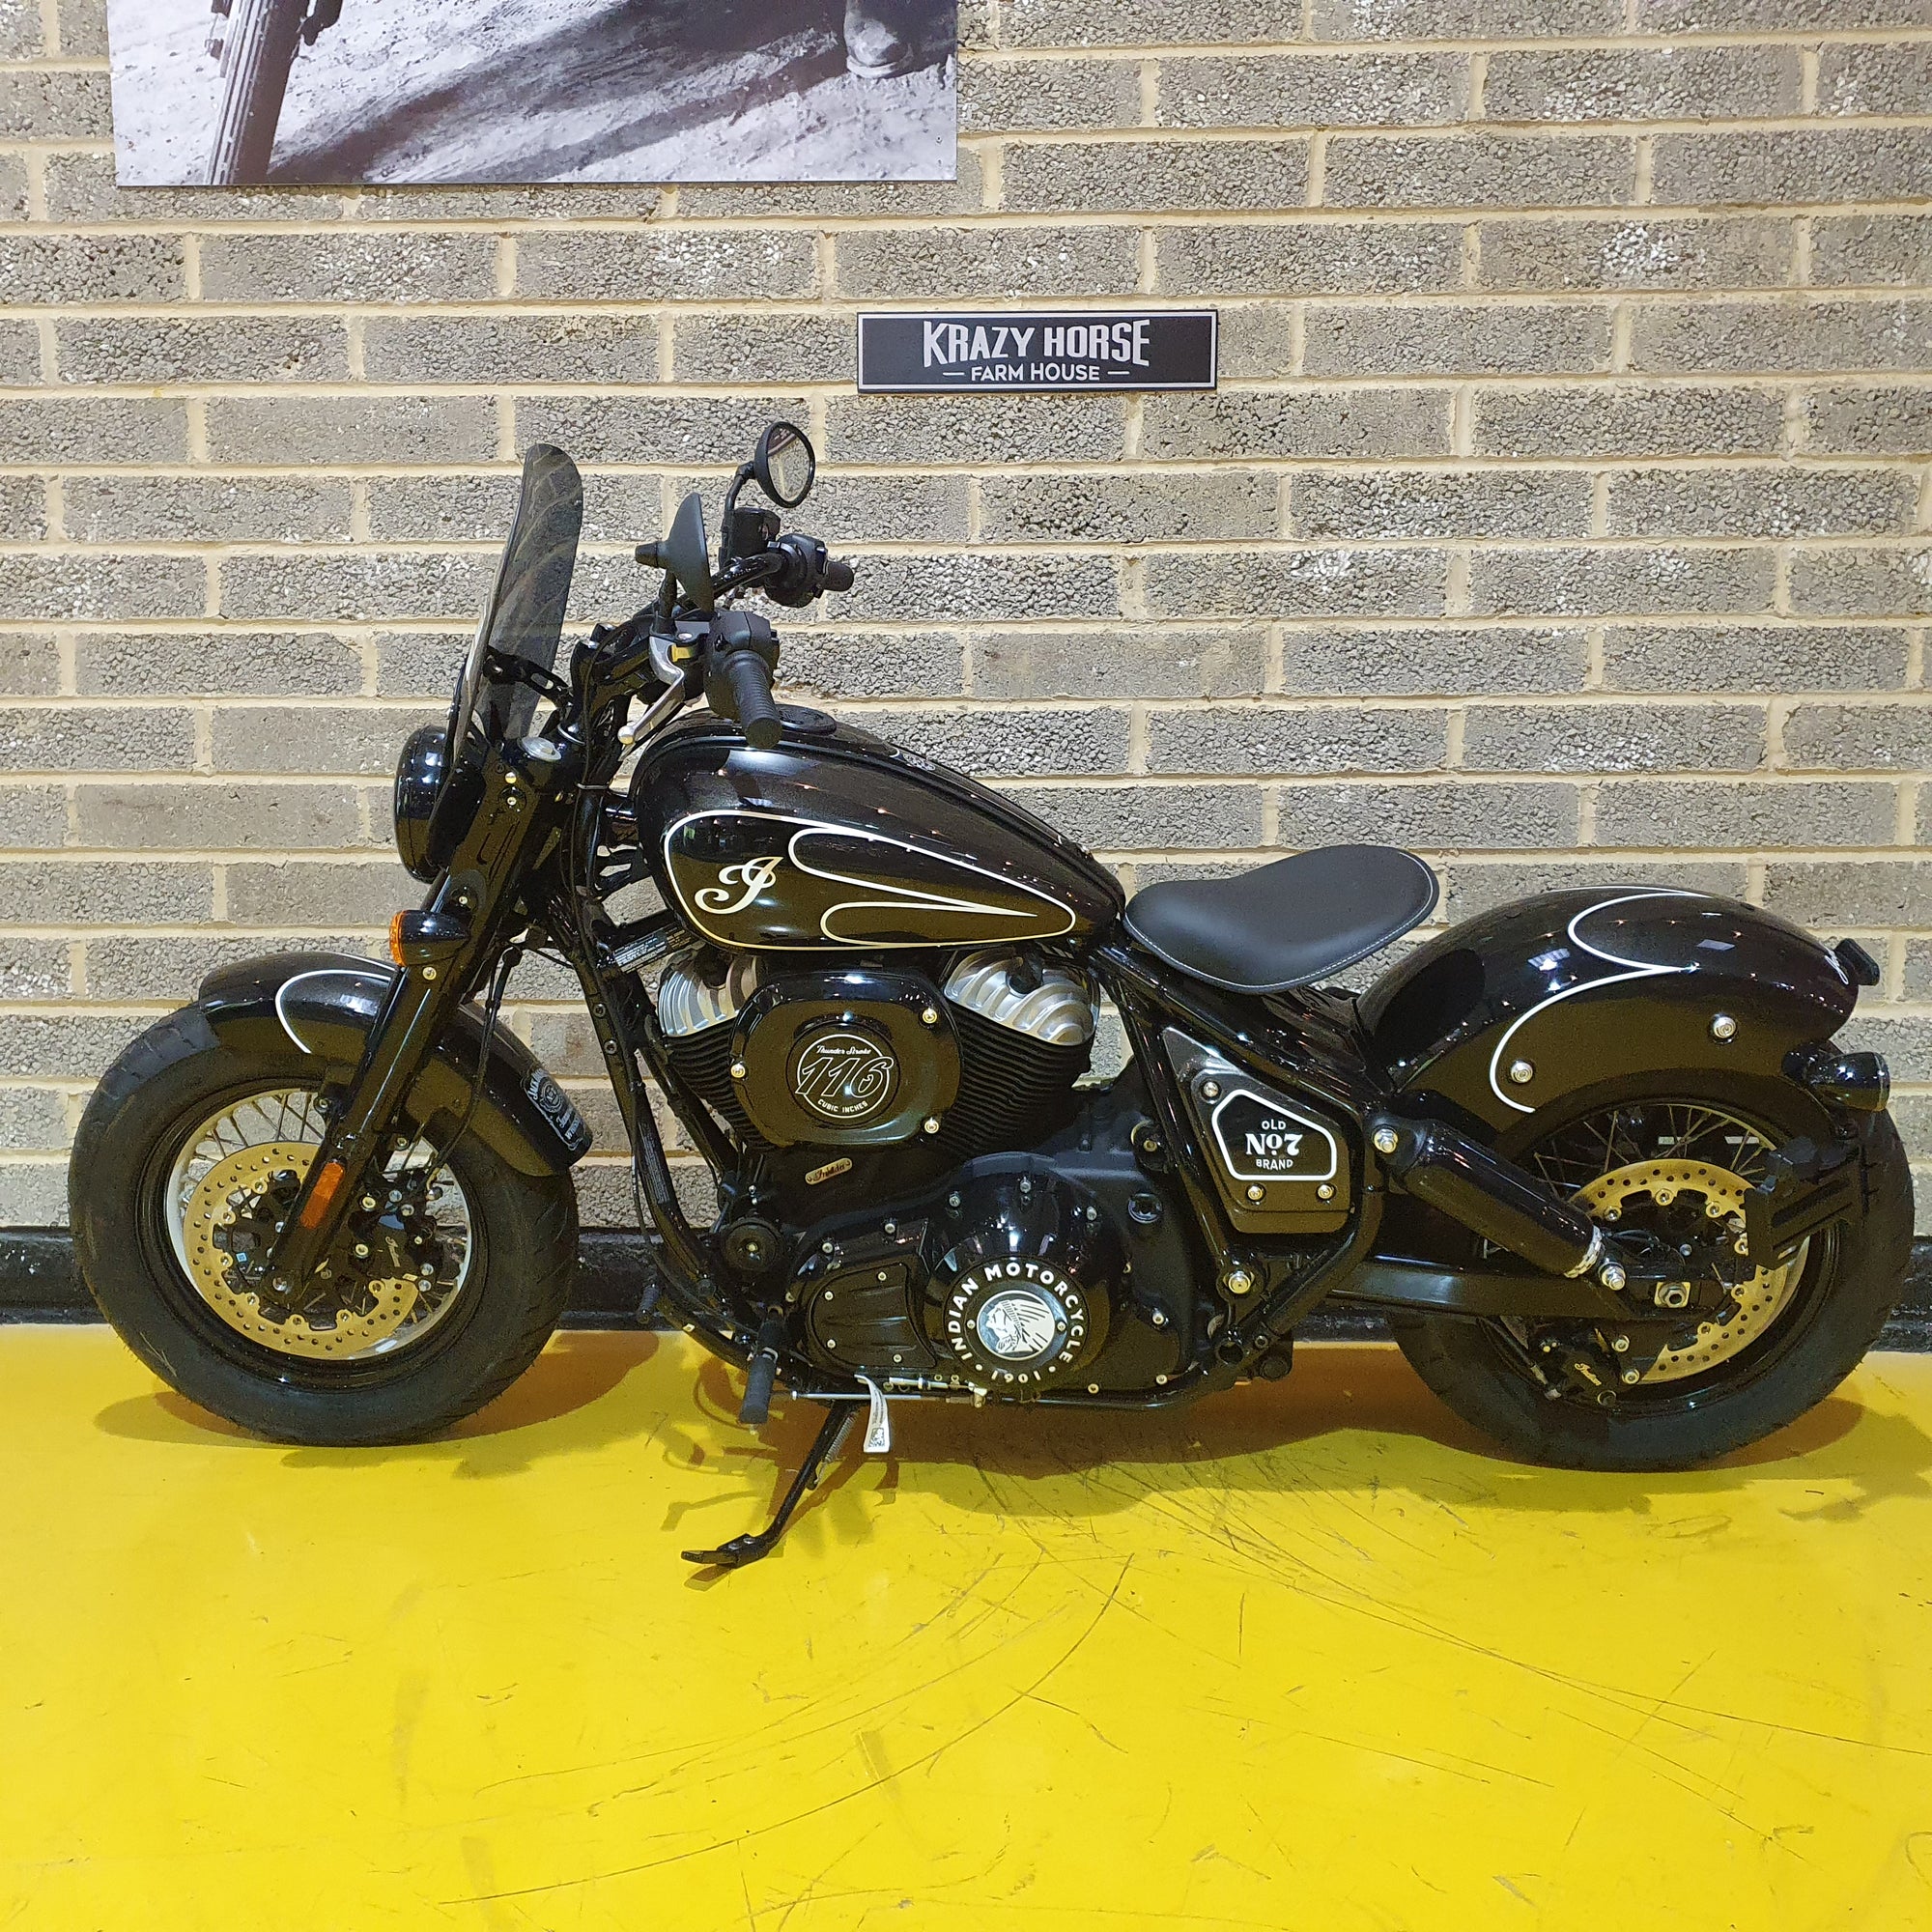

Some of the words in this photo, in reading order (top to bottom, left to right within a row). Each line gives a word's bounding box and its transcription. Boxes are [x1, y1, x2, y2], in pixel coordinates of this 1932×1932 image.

[923, 320, 1036, 368] KRAZY
[1043, 319, 1151, 367] HORSE
[971, 363, 1024, 382] FARM
[1030, 362, 1100, 382] HOUSE
[795, 1056, 895, 1098] 116
[817, 1098, 838, 1112] CUBIC
[841, 1100, 868, 1113] INCHES
[1261, 1119, 1287, 1130] OLD
[1256, 1158, 1293, 1170] BRAND
[948, 1277, 979, 1360] INDIAN
[984, 1262, 1084, 1363] MOTORCYCLE
[991, 1370, 1041, 1383] 1901
